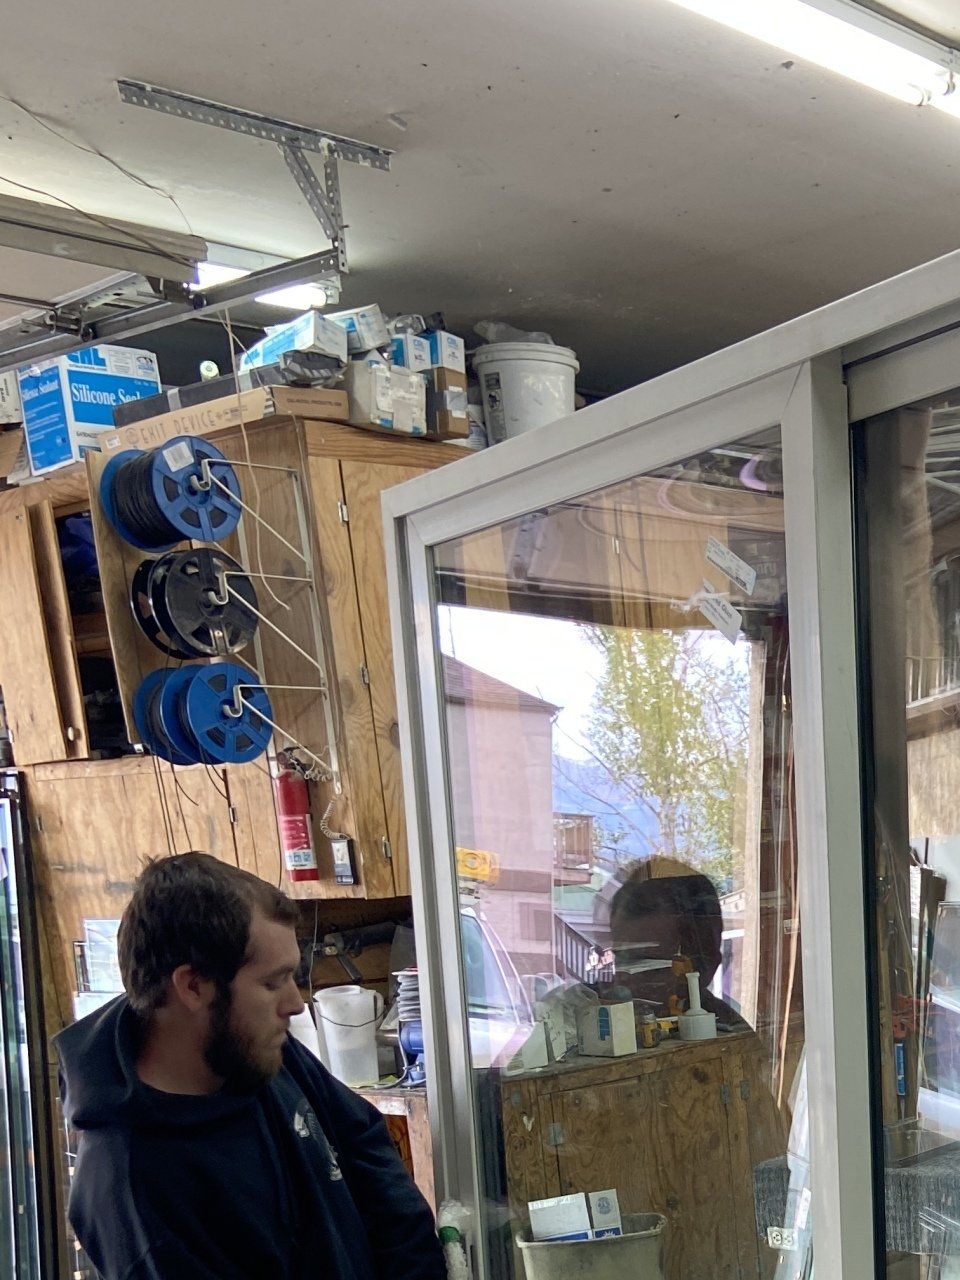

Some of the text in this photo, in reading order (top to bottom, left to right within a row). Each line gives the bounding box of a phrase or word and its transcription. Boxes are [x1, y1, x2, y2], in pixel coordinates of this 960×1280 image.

[71, 383, 117, 406] Silicone
[117, 388, 145, 403] Seal
[140, 422, 167, 444] EXIT
[173, 410, 217, 435] DEVICE
